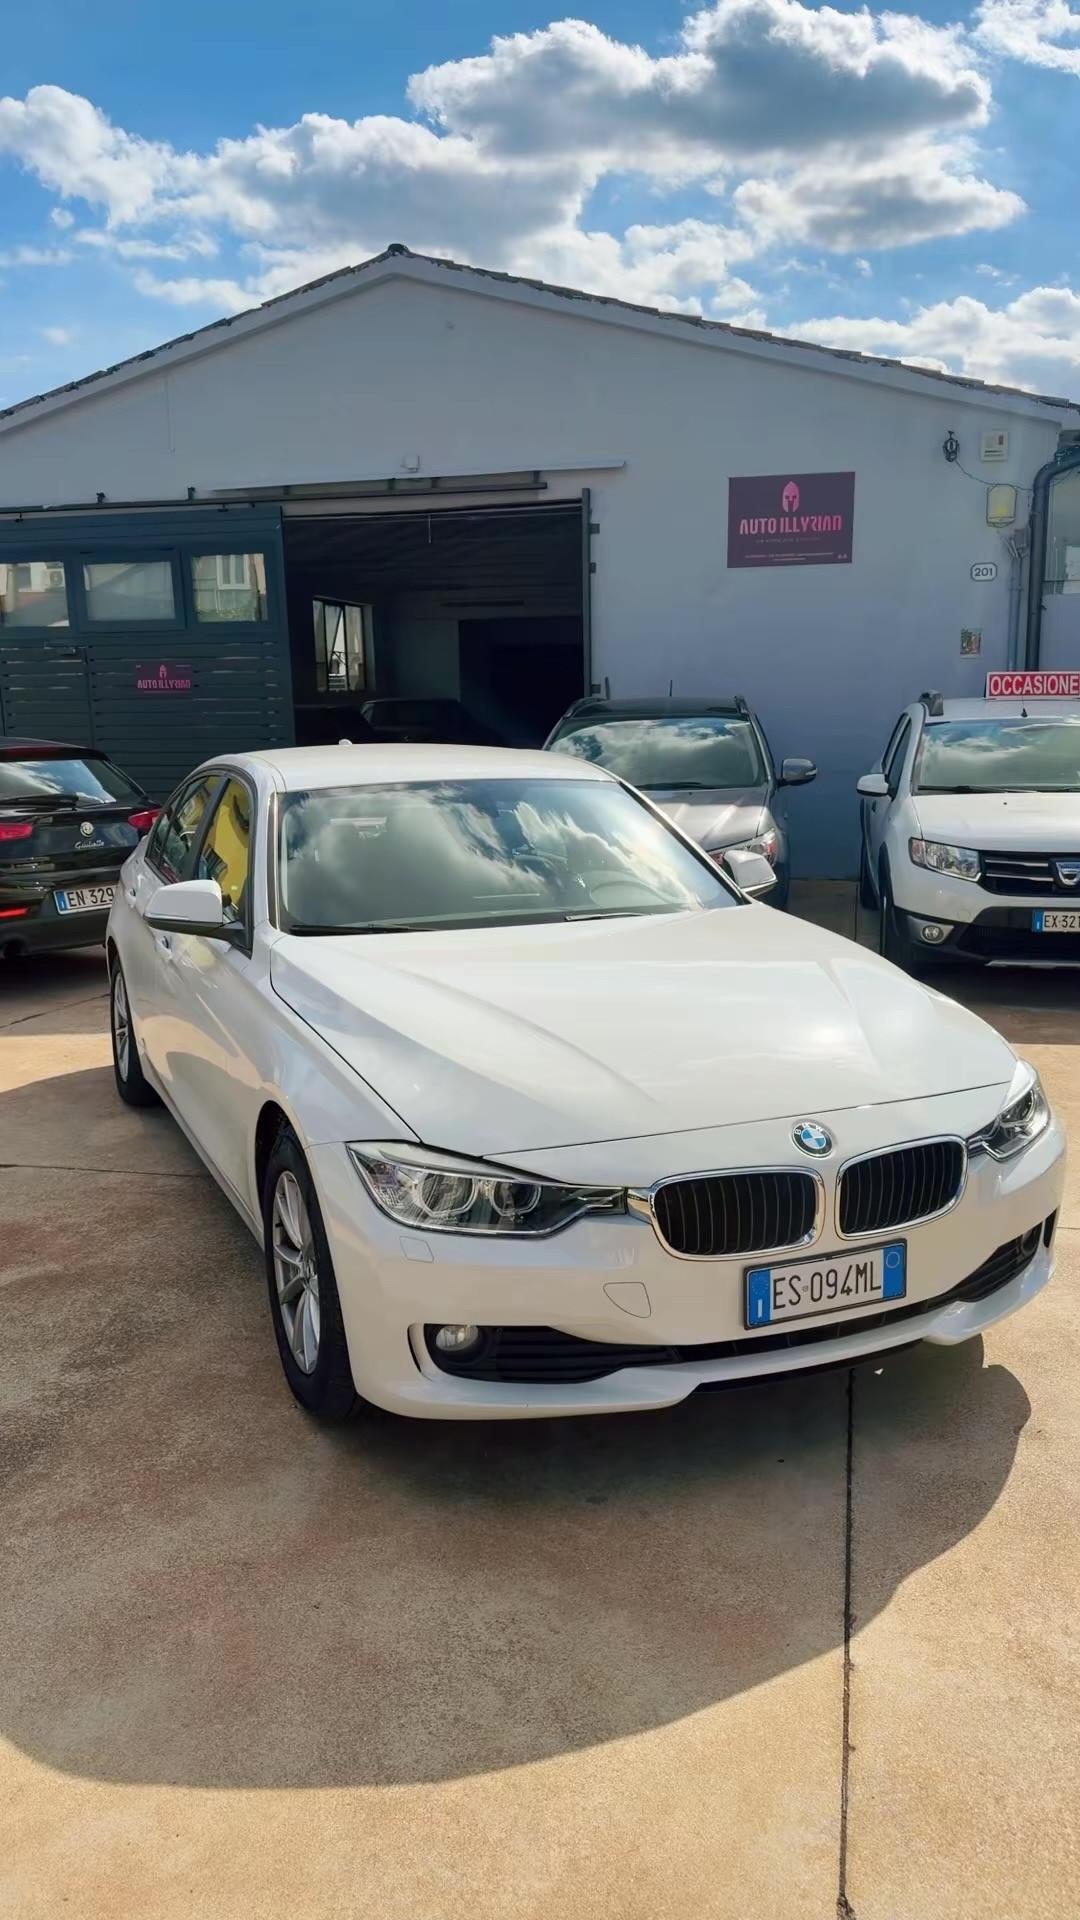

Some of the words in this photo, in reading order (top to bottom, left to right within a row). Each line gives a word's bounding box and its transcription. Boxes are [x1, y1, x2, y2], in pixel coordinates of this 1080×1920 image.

[740, 517, 777, 535] AUTO
[974, 567, 993, 577] 201
[137, 679, 157, 689] AUTO
[990, 675, 1079, 695] OCCASIONE
[67, 891, 86, 907] EN
[89, 887, 114, 904] 329
[1044, 915, 1058, 928] EX
[772, 1275, 802, 1311] ES
[810, 1261, 882, 1303] 094ML
